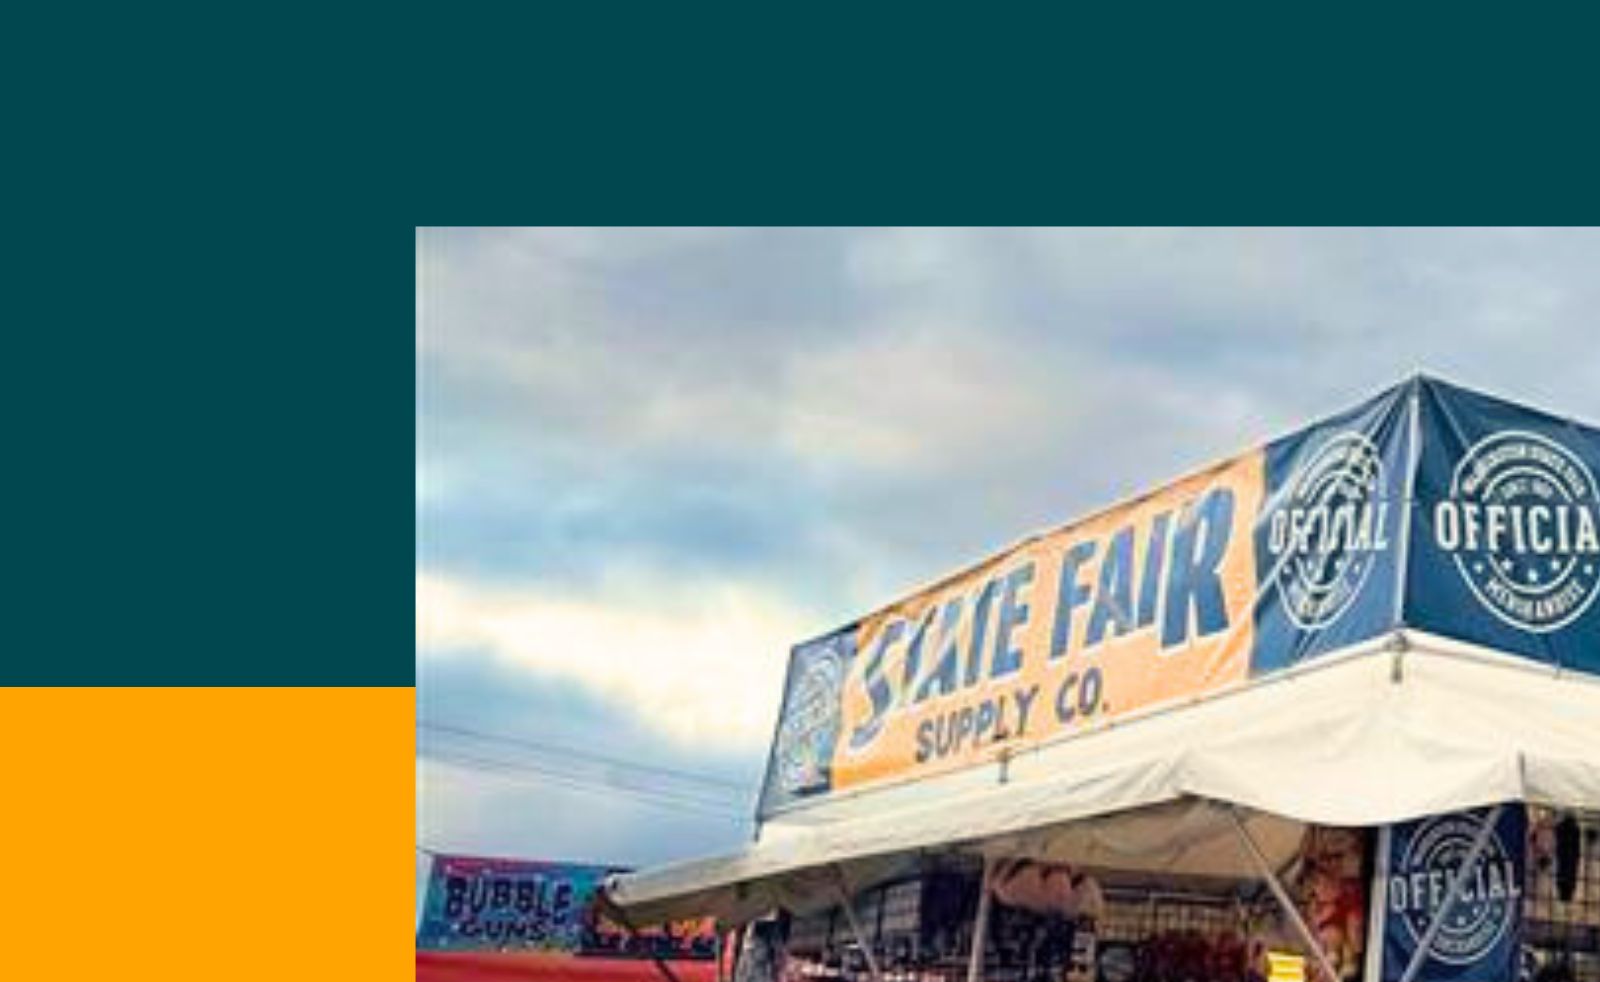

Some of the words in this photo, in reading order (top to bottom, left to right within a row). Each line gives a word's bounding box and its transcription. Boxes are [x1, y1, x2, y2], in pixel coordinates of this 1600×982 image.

[848, 560, 1036, 750] STATE
[1049, 487, 1236, 650] FAIR
[915, 684, 1041, 763] SUPPLY
[1054, 666, 1111, 726] CO.
[443, 874, 574, 925] BUBBLE
[456, 917, 549, 942] GUNS
